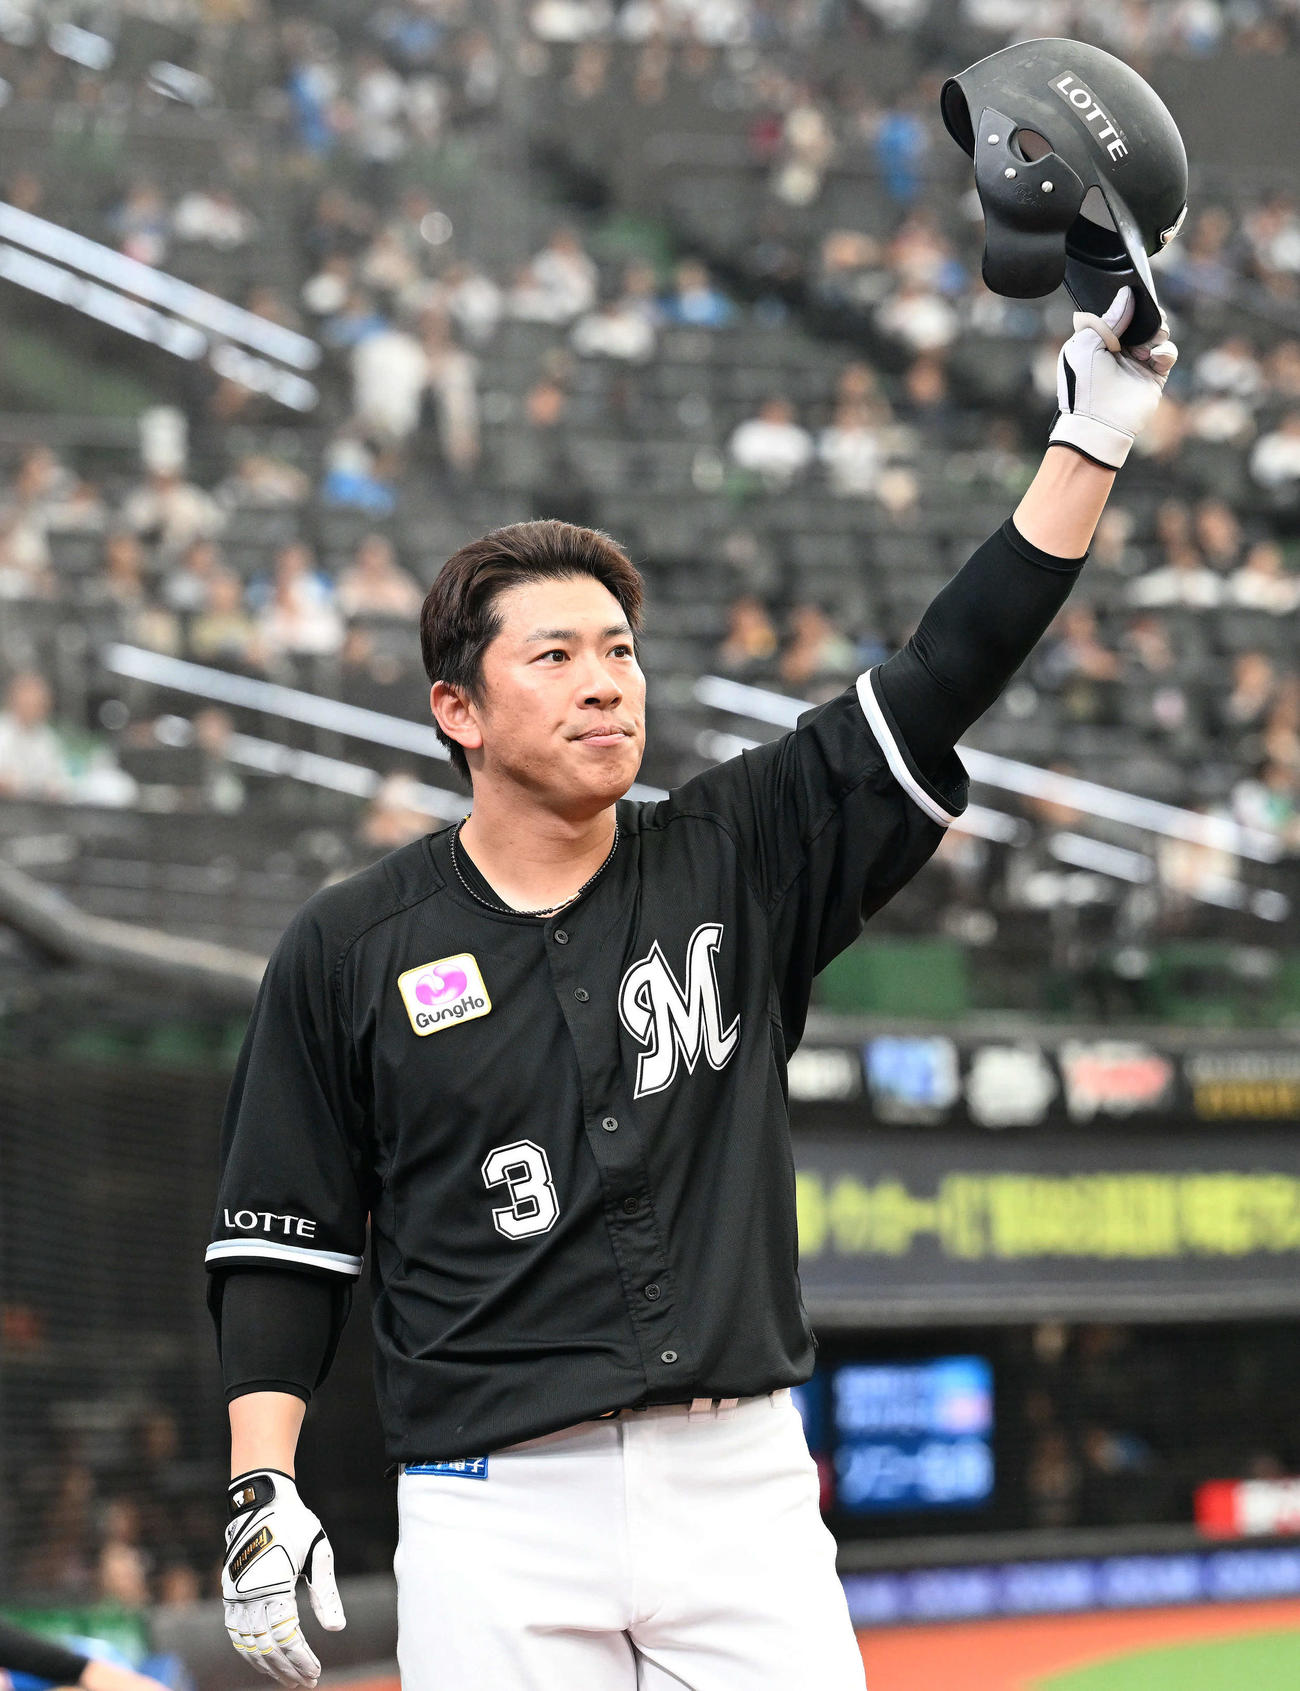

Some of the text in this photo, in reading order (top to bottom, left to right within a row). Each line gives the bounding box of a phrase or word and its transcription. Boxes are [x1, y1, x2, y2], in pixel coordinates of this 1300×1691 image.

[1056, 76, 1129, 162] LOTTE
[415, 995, 485, 1029] GungHo
[618, 922, 741, 1100] M
[223, 1208, 317, 1239] LOTTE
[481, 1139, 561, 1241] 3
